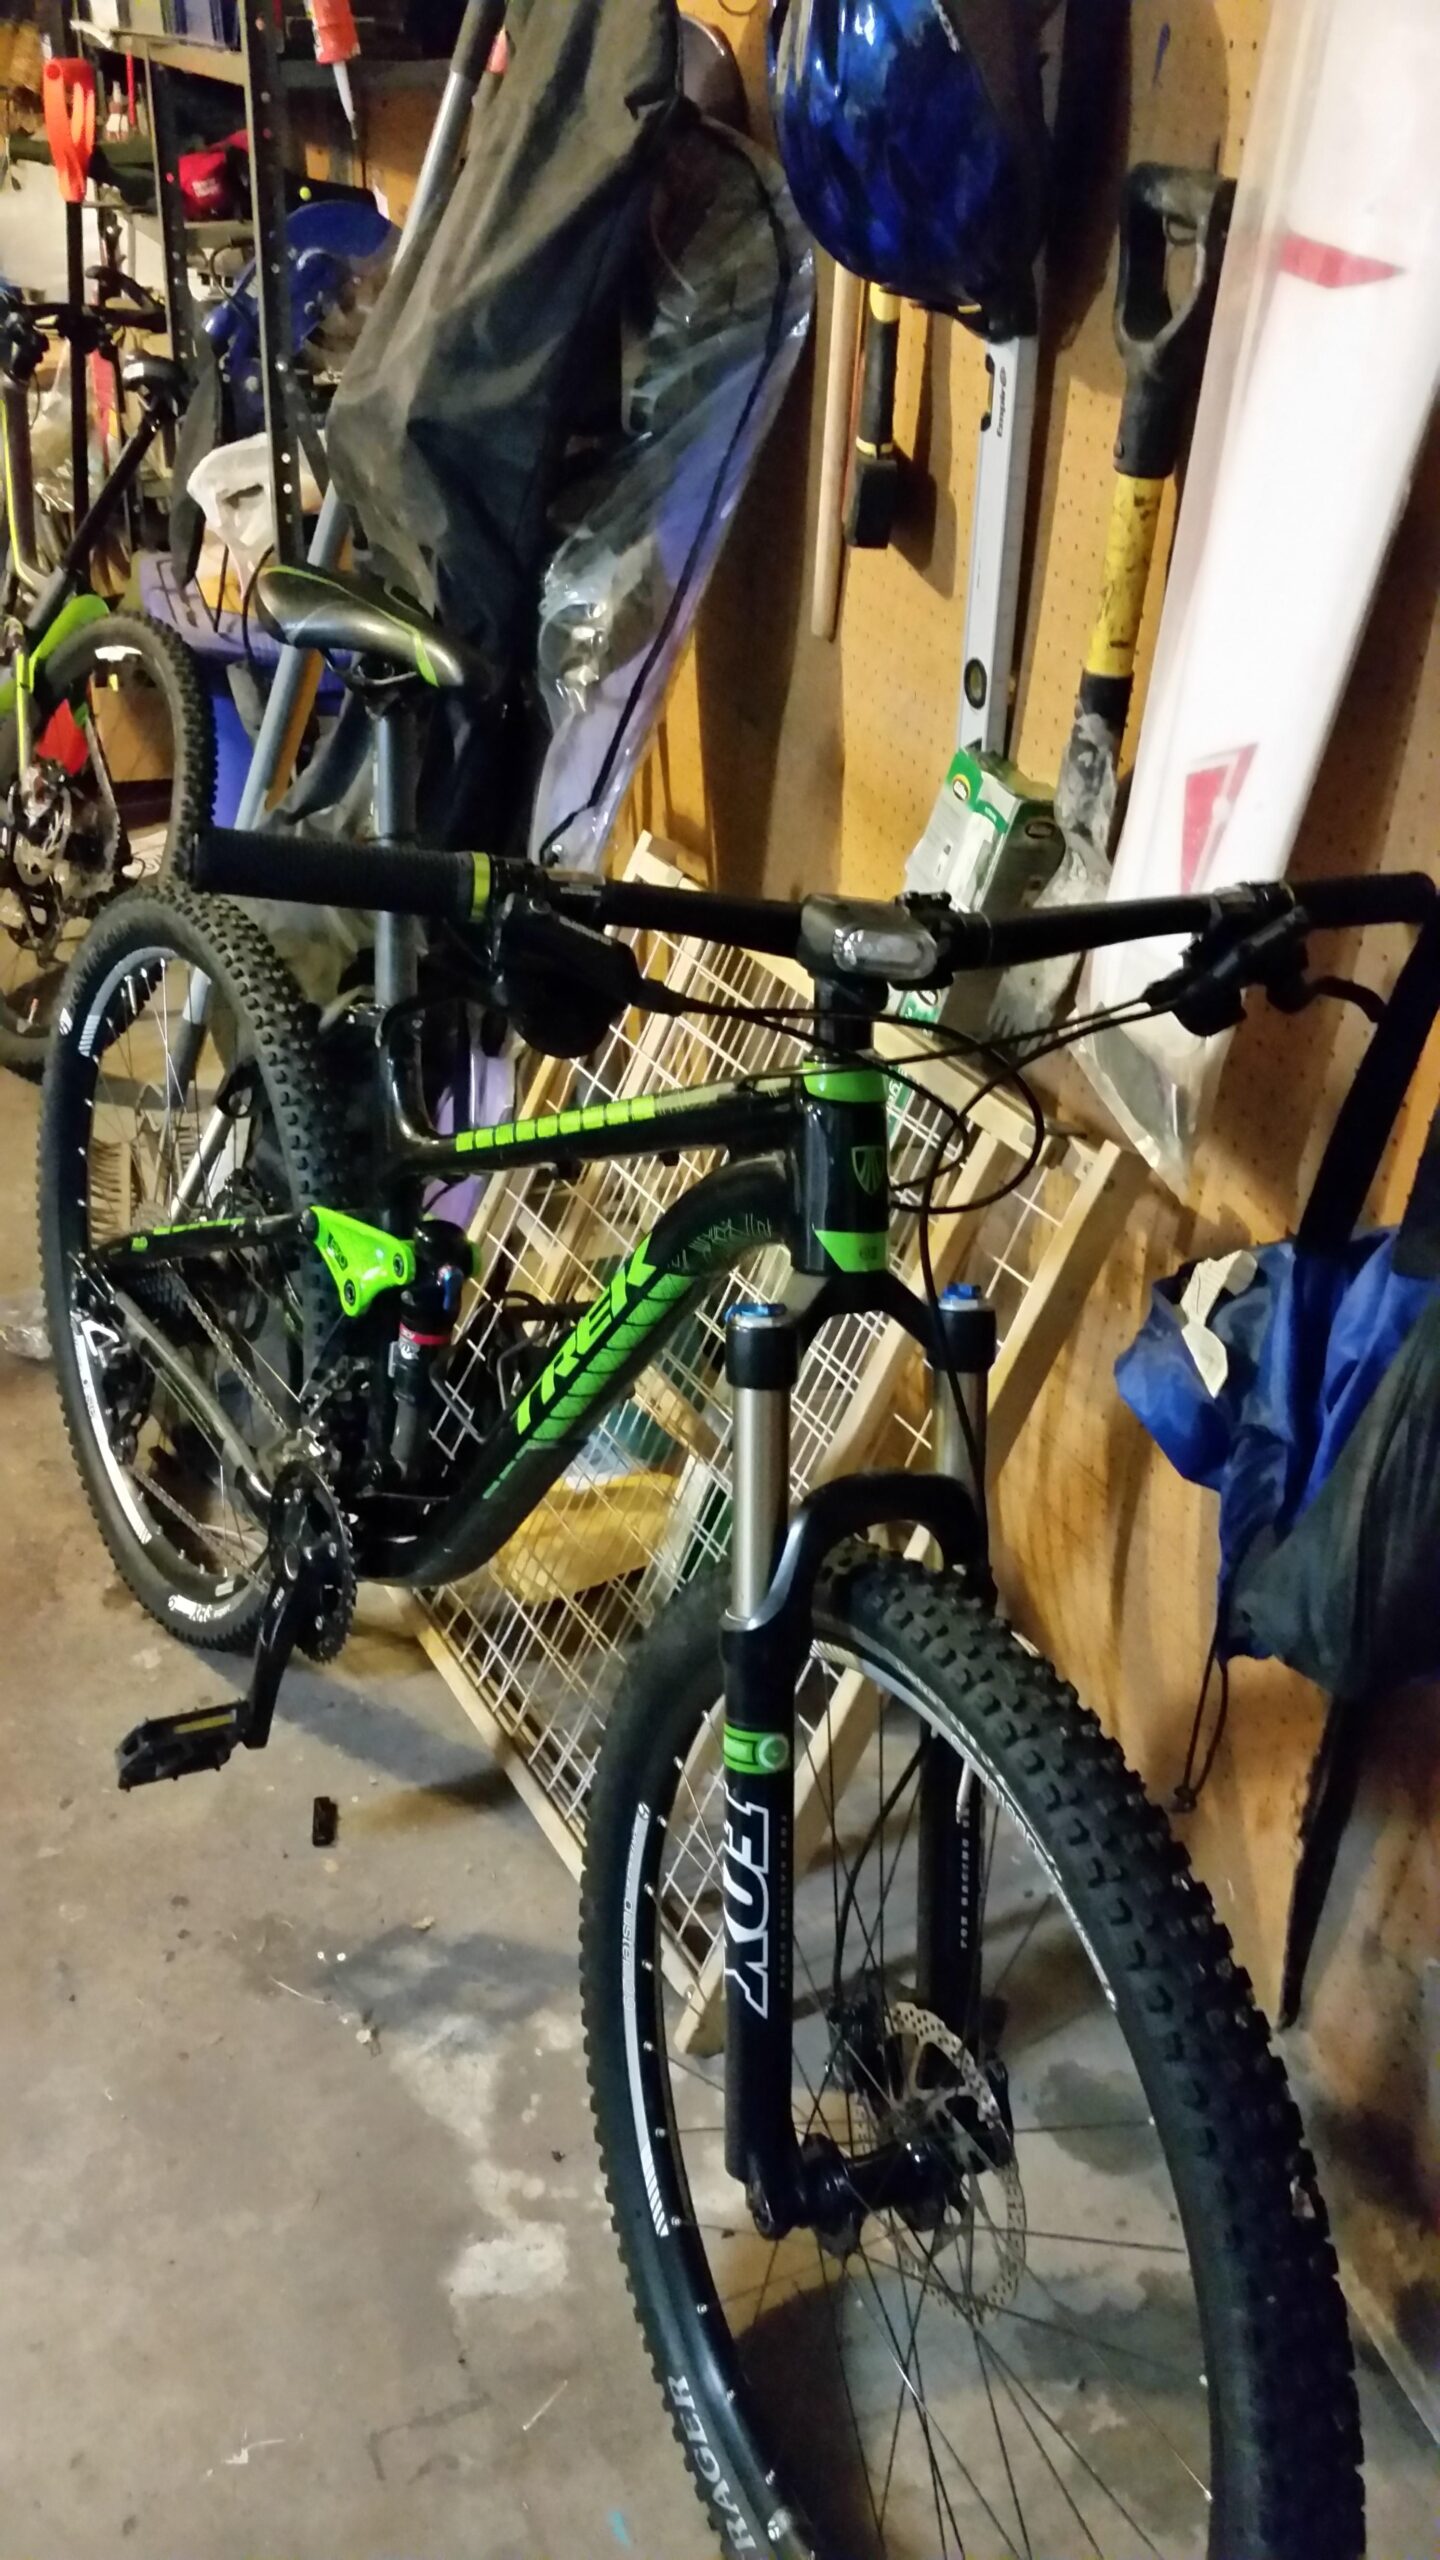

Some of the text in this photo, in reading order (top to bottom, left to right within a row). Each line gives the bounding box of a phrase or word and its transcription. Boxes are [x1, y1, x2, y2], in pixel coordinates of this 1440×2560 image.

[511, 1235, 658, 1436] TREK
[723, 1778, 769, 2019] FOX
[667, 2375, 757, 2555] RAGER
